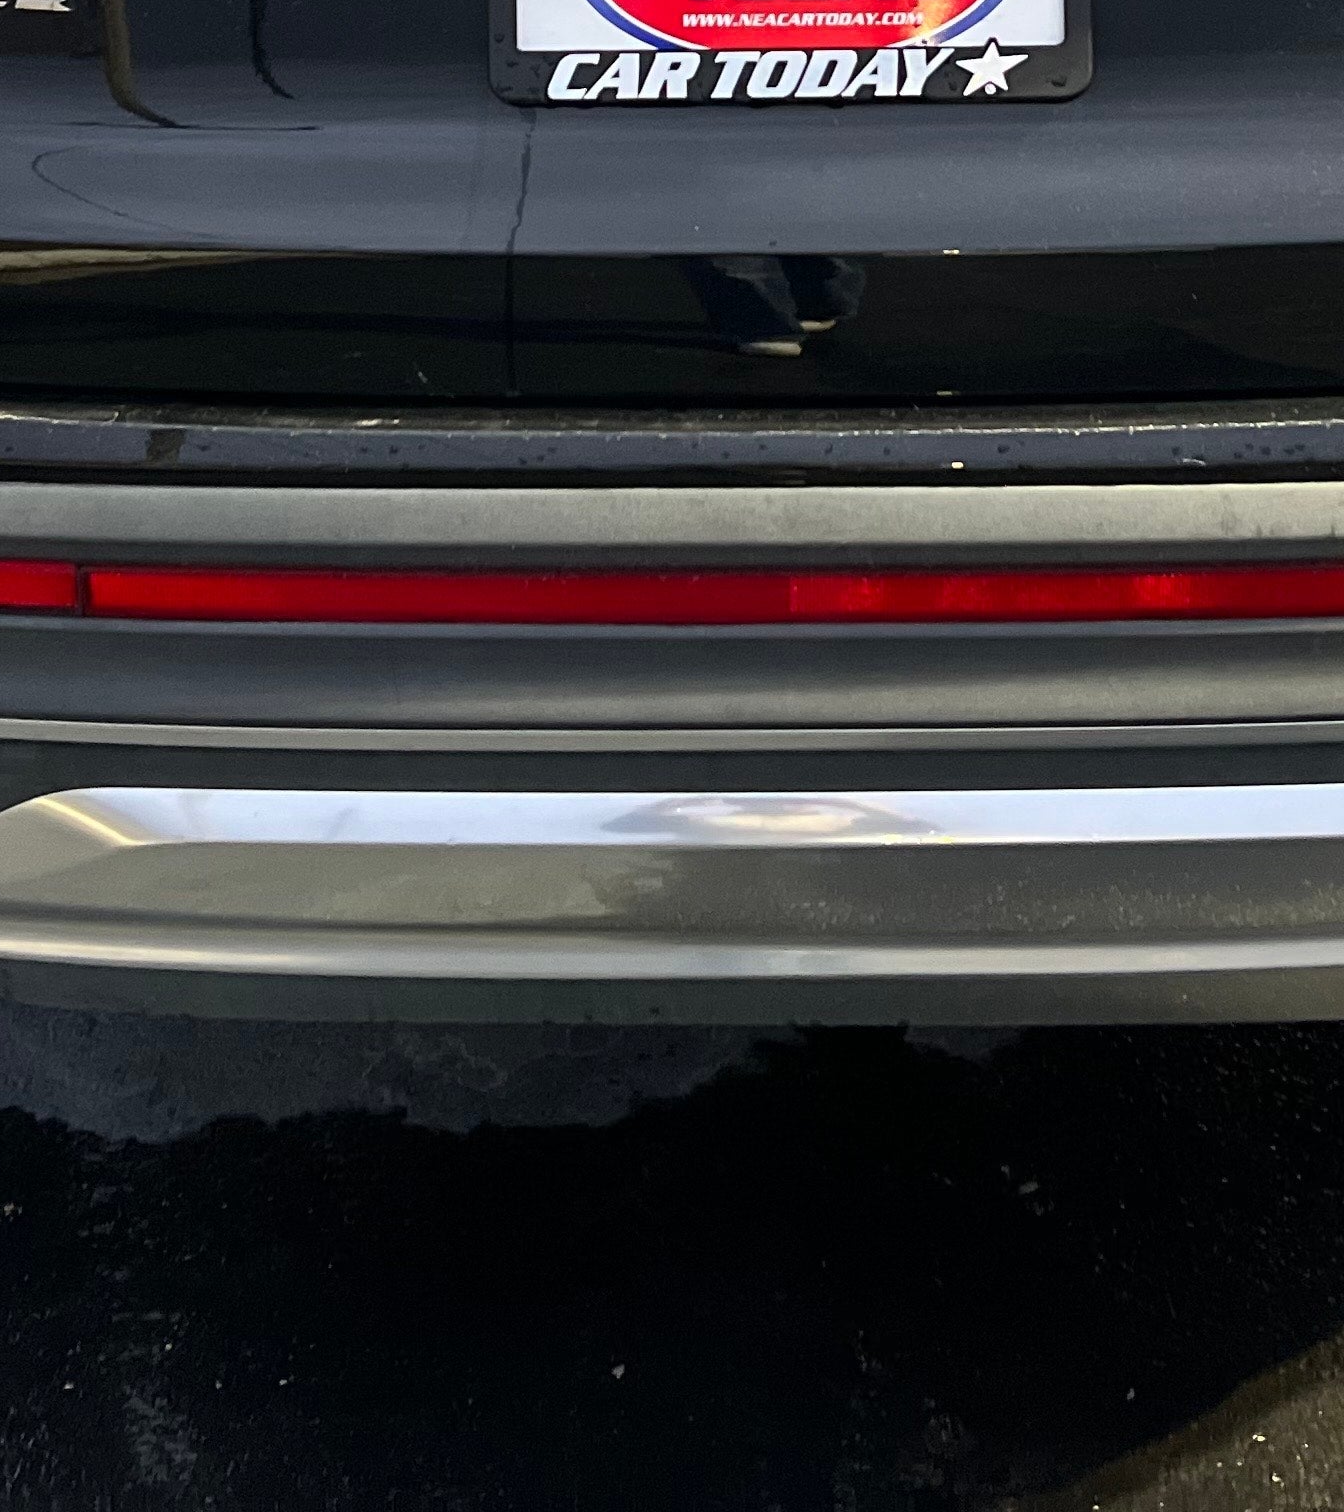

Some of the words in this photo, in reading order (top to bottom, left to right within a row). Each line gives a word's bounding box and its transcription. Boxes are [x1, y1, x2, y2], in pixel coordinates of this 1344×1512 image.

[682, 12, 924, 28] WWW.NEACARTODAY.COM
[548, 52, 704, 101] CAR
[710, 47, 955, 100] TODAY
